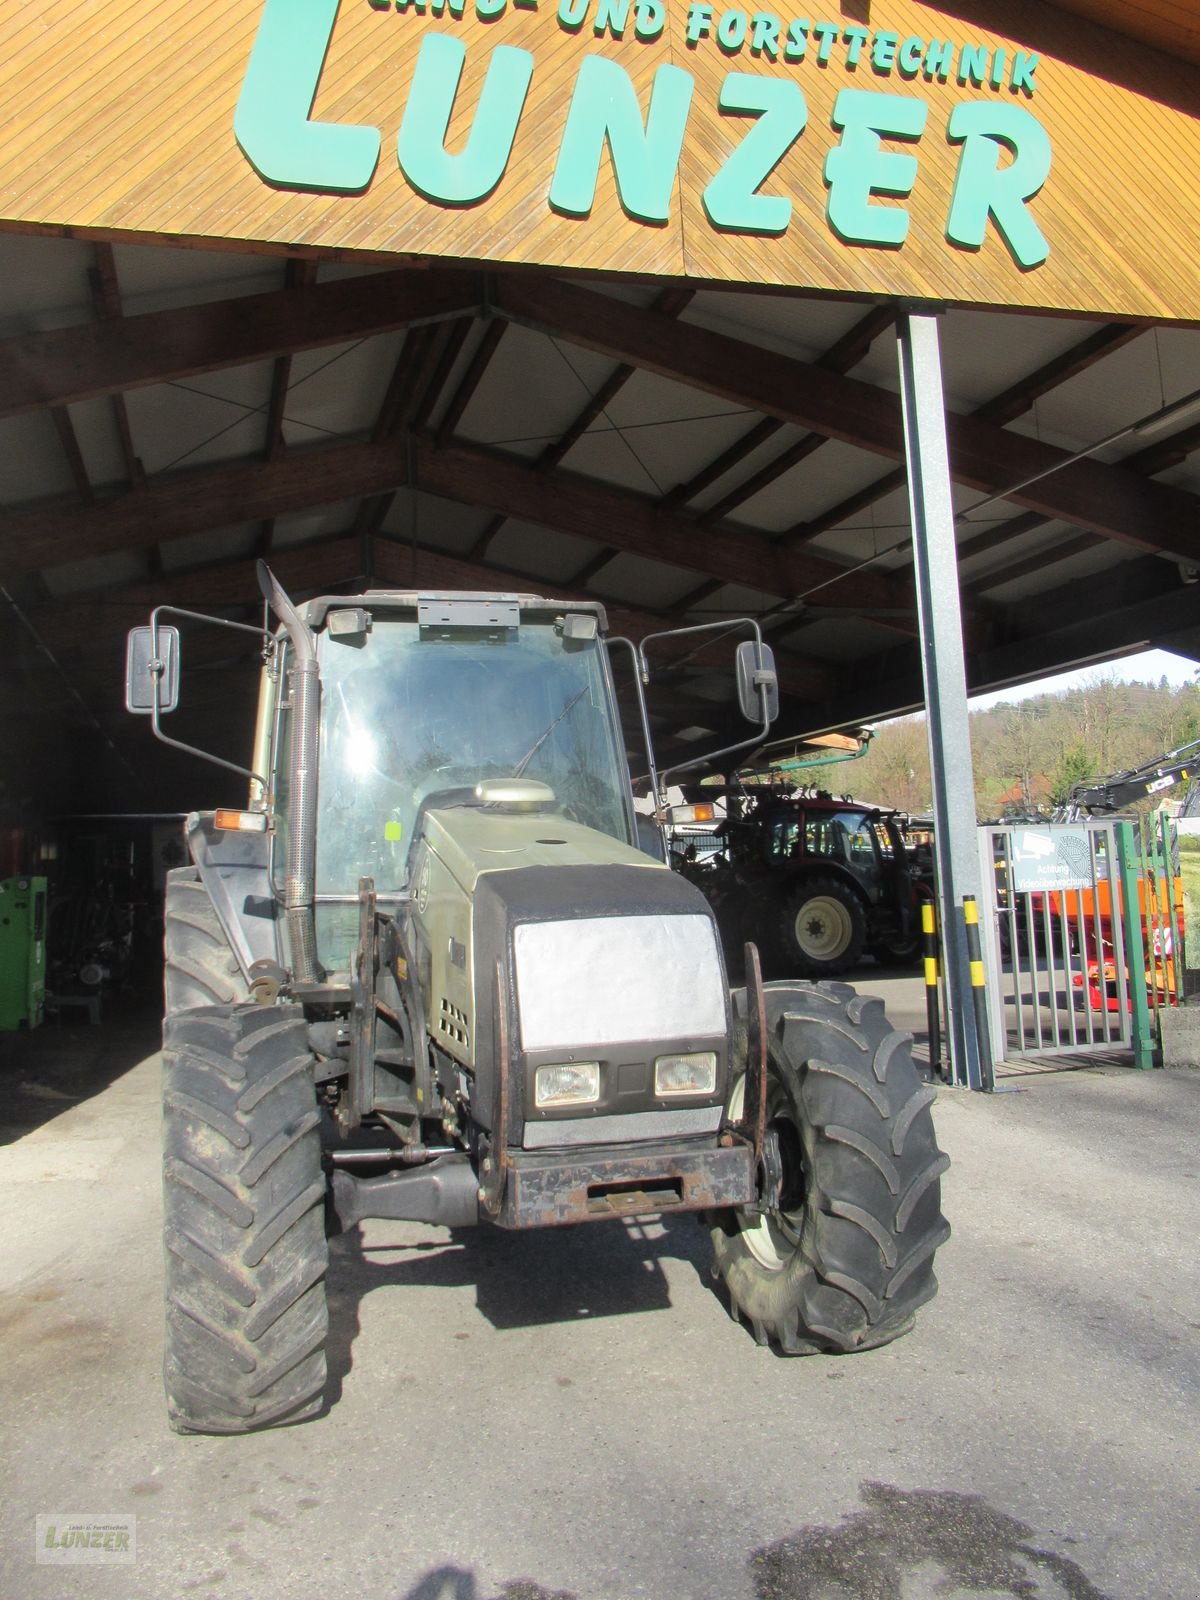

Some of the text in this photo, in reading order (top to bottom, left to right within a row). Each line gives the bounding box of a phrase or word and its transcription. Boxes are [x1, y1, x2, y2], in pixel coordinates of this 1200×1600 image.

[557, 0, 1040, 94] UND FORSTTECHNIK
[233, 0, 1053, 270] LUNZER
[1145, 775, 1175, 794] JCB
[1037, 864, 1070, 875] Achtung
[1018, 876, 1090, 889] Videoüberwachung
